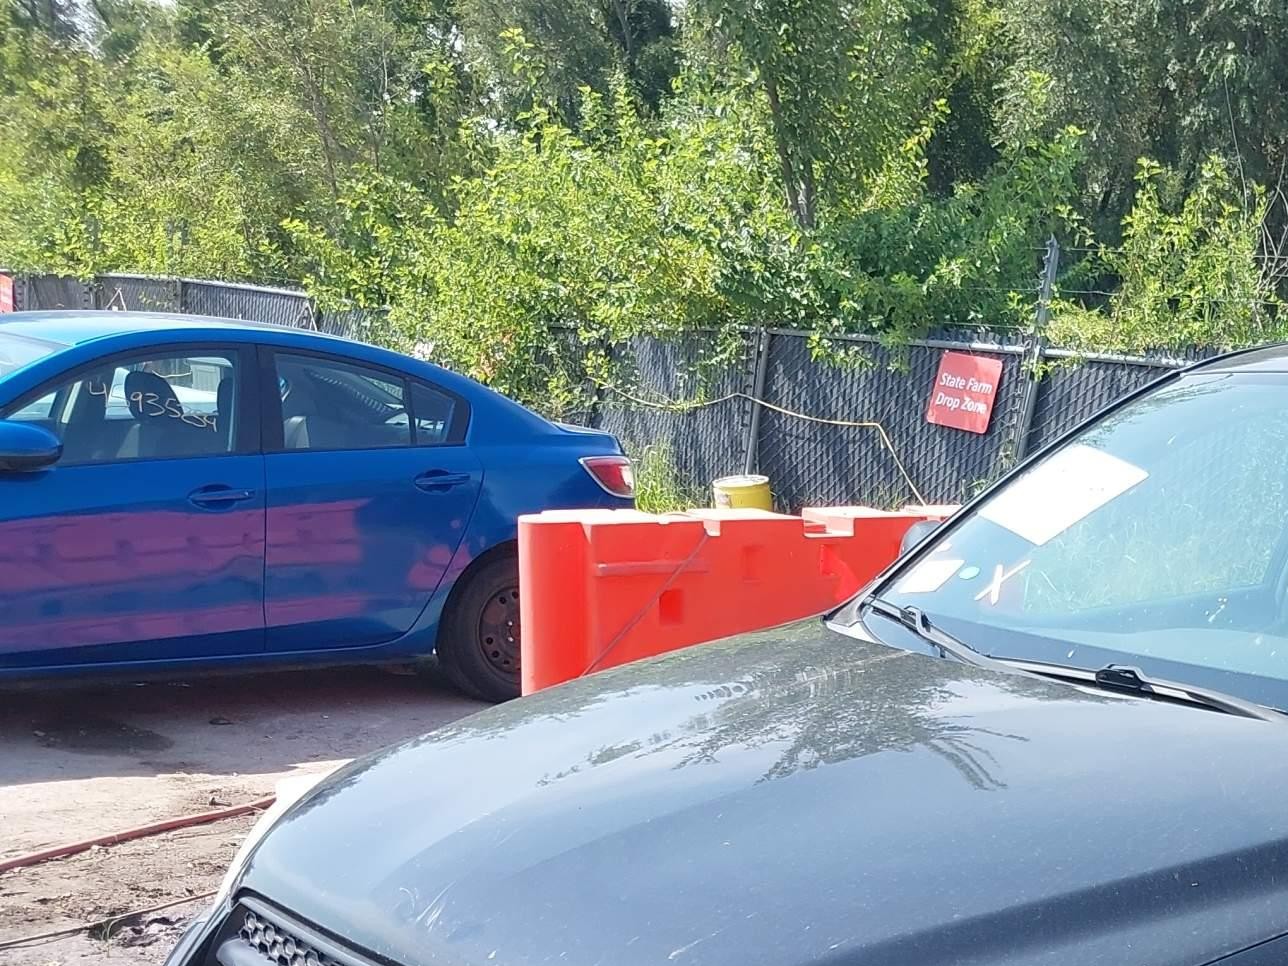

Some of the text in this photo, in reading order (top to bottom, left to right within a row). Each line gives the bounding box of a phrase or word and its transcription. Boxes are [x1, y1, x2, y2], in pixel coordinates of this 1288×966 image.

[940, 373, 992, 393] State Farm
[936, 393, 987, 414] Drop Zone
